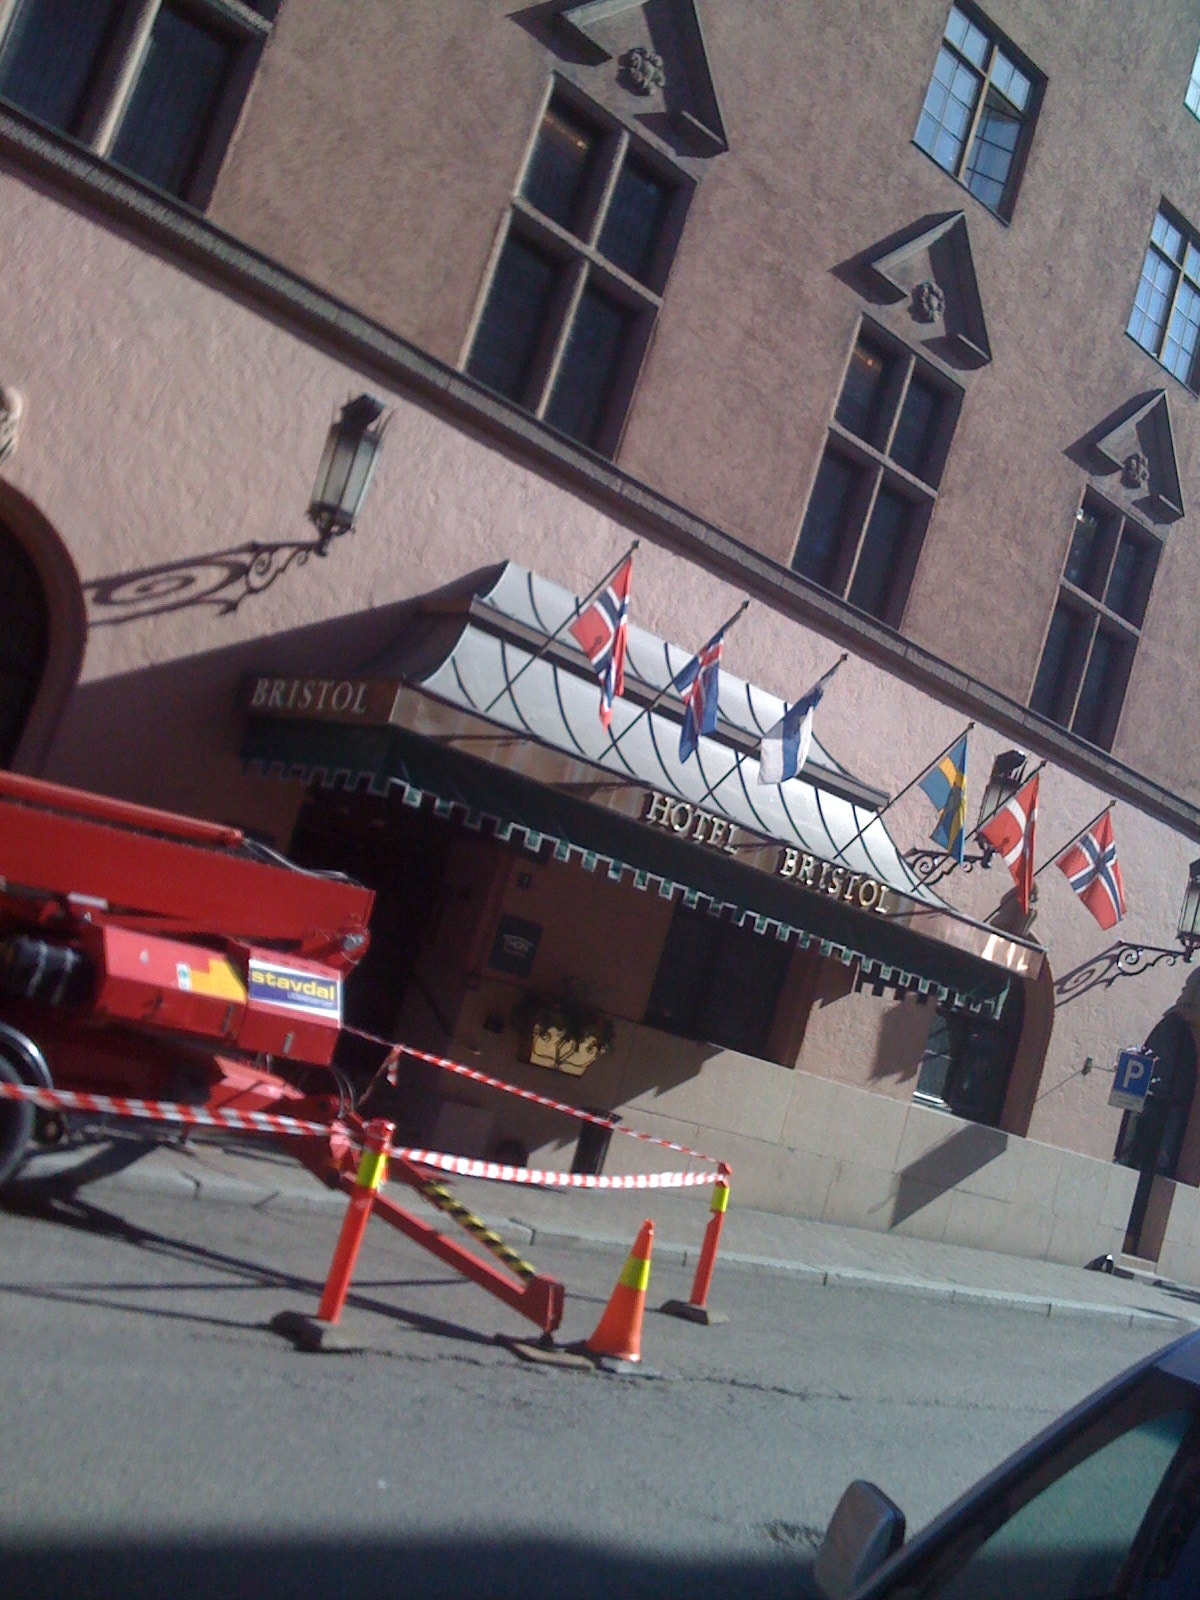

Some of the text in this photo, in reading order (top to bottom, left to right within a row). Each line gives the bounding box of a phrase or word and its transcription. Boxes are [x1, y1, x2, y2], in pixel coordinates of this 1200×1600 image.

[251, 677, 367, 714] BRISTOL
[646, 790, 891, 914] HOTEL BRISTOL
[251, 970, 335, 1001] stavdal
[1122, 1059, 1145, 1088] P
